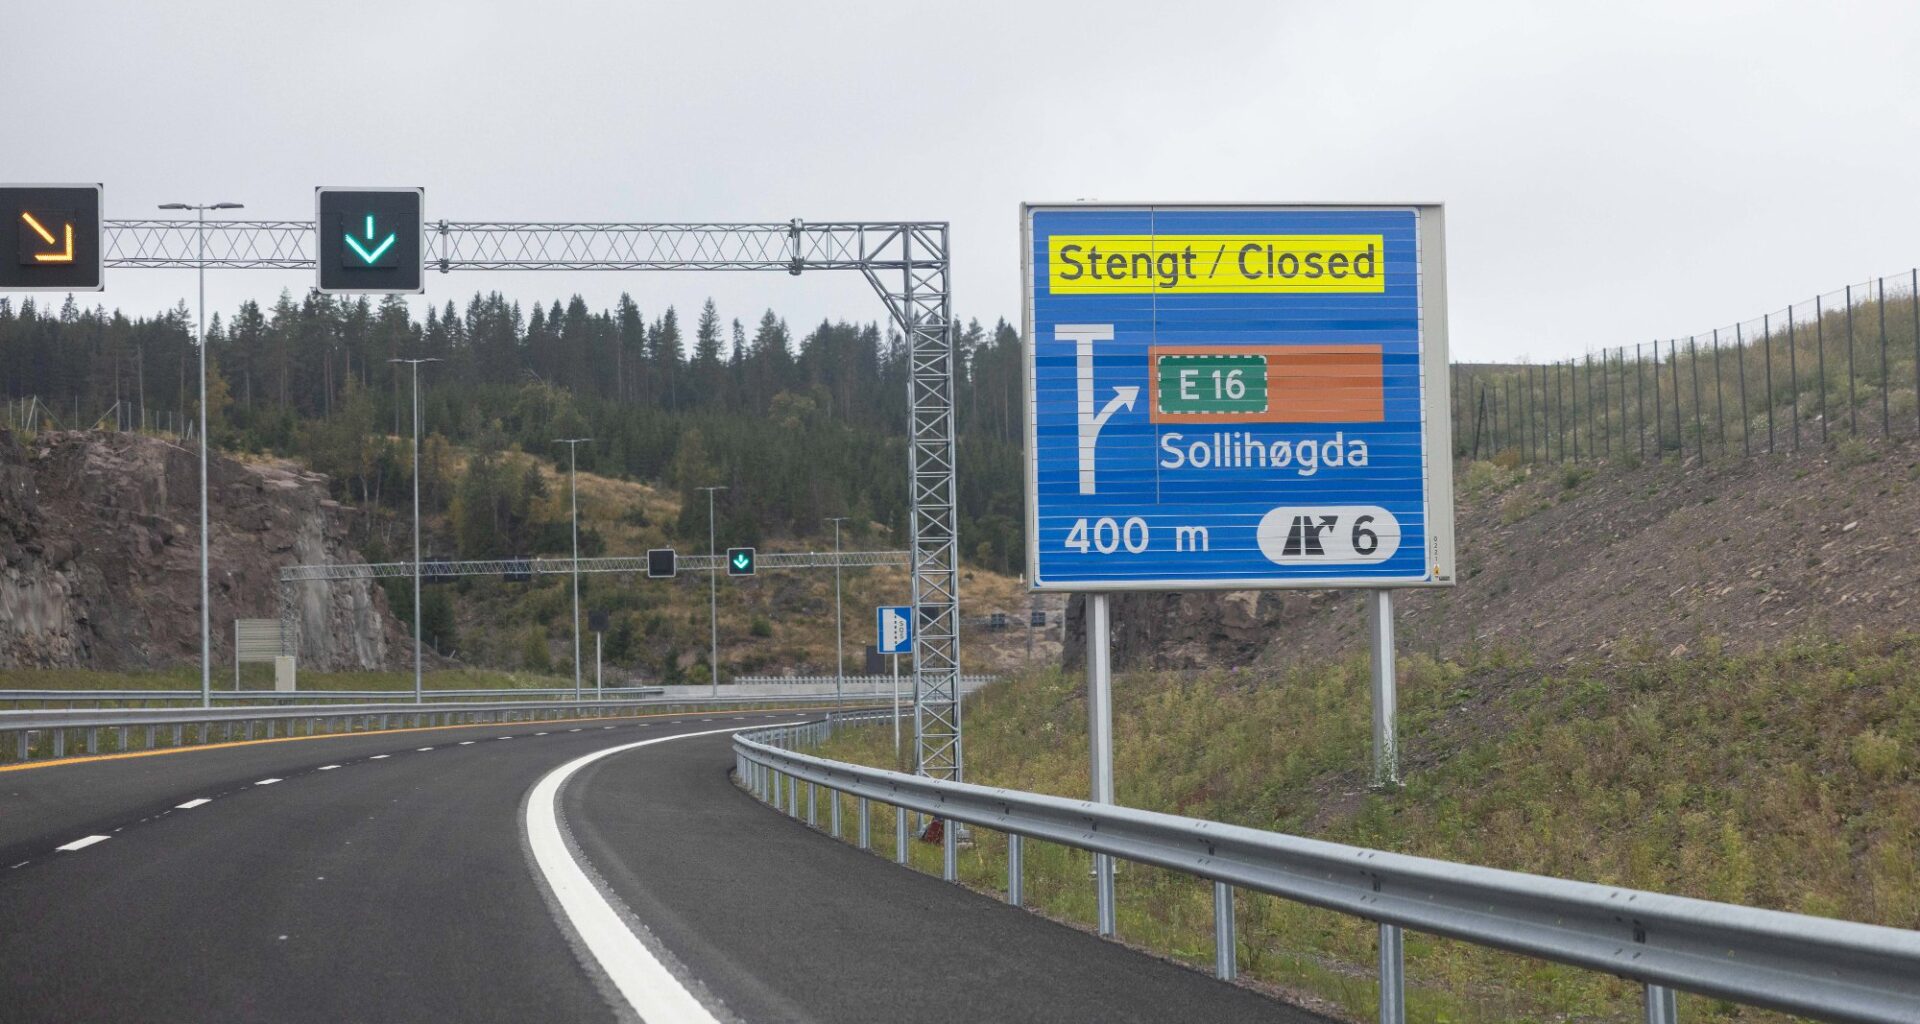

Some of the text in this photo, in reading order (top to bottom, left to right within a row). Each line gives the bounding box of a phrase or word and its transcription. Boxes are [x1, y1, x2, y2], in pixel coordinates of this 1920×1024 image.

[1059, 243, 1375, 288] Stengt / Closed
[1180, 369, 1246, 400] E 16
[1160, 431, 1369, 476] Sollihøgda
[1064, 516, 1209, 554] 400 m
[1352, 514, 1379, 556] 6
